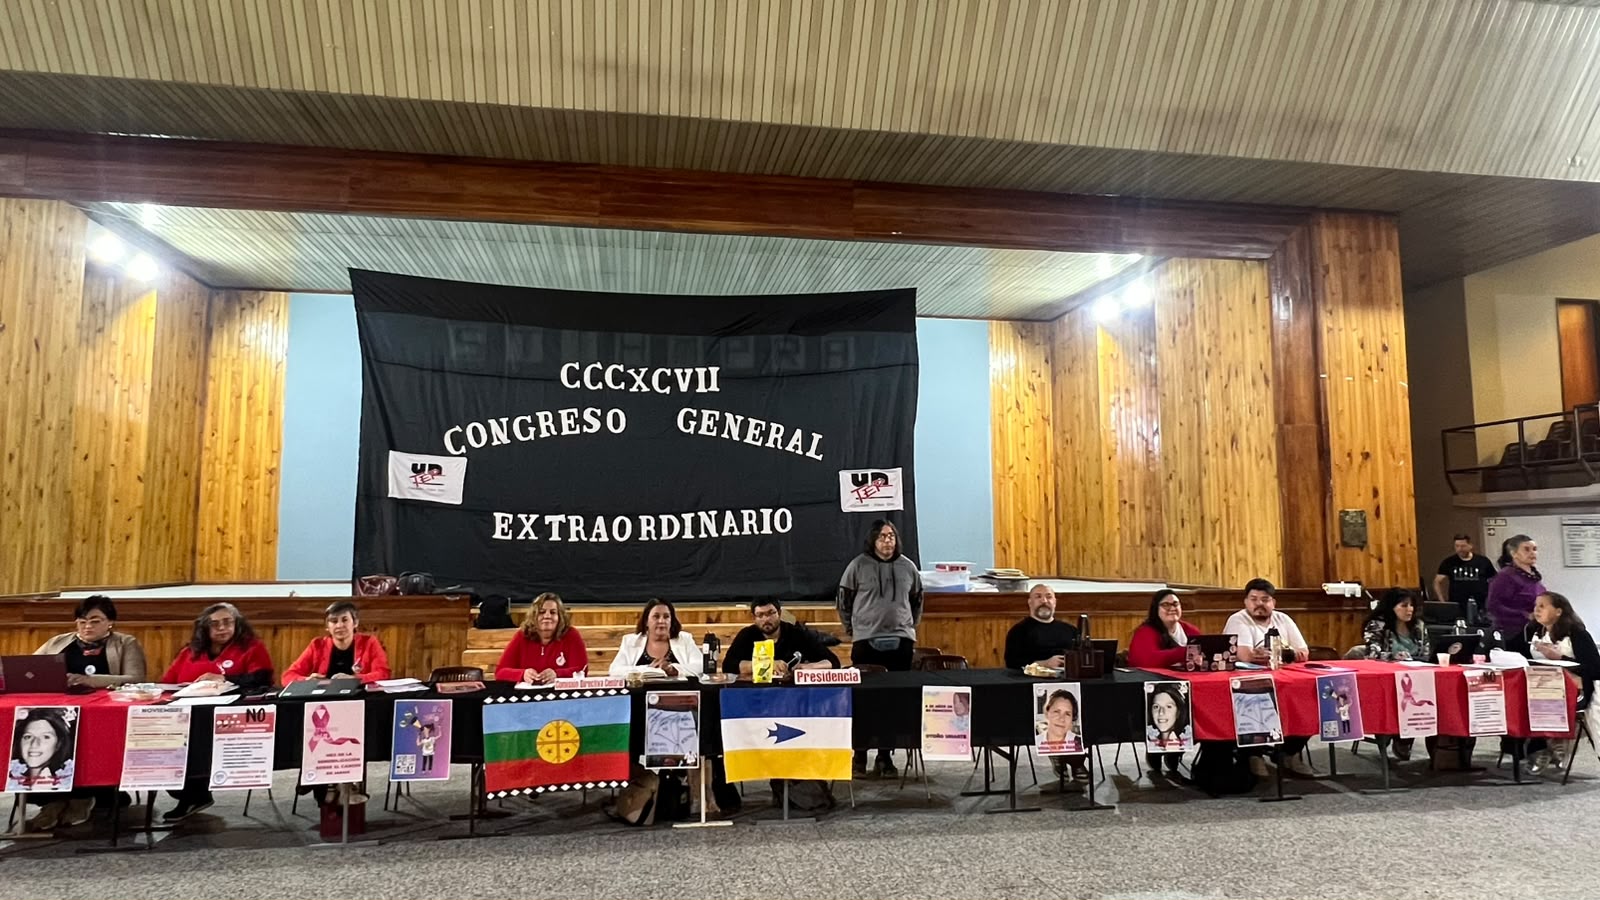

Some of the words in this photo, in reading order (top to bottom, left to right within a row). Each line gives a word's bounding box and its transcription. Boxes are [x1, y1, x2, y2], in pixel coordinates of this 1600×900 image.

[560, 361, 720, 396] CCCXCVII
[443, 407, 627, 455] CONGRESO
[676, 407, 824, 461] GENERAL
[491, 508, 793, 542] EXTRAORDINARIO
[796, 670, 859, 683] Presidencia
[245, 707, 266, 723] NO
